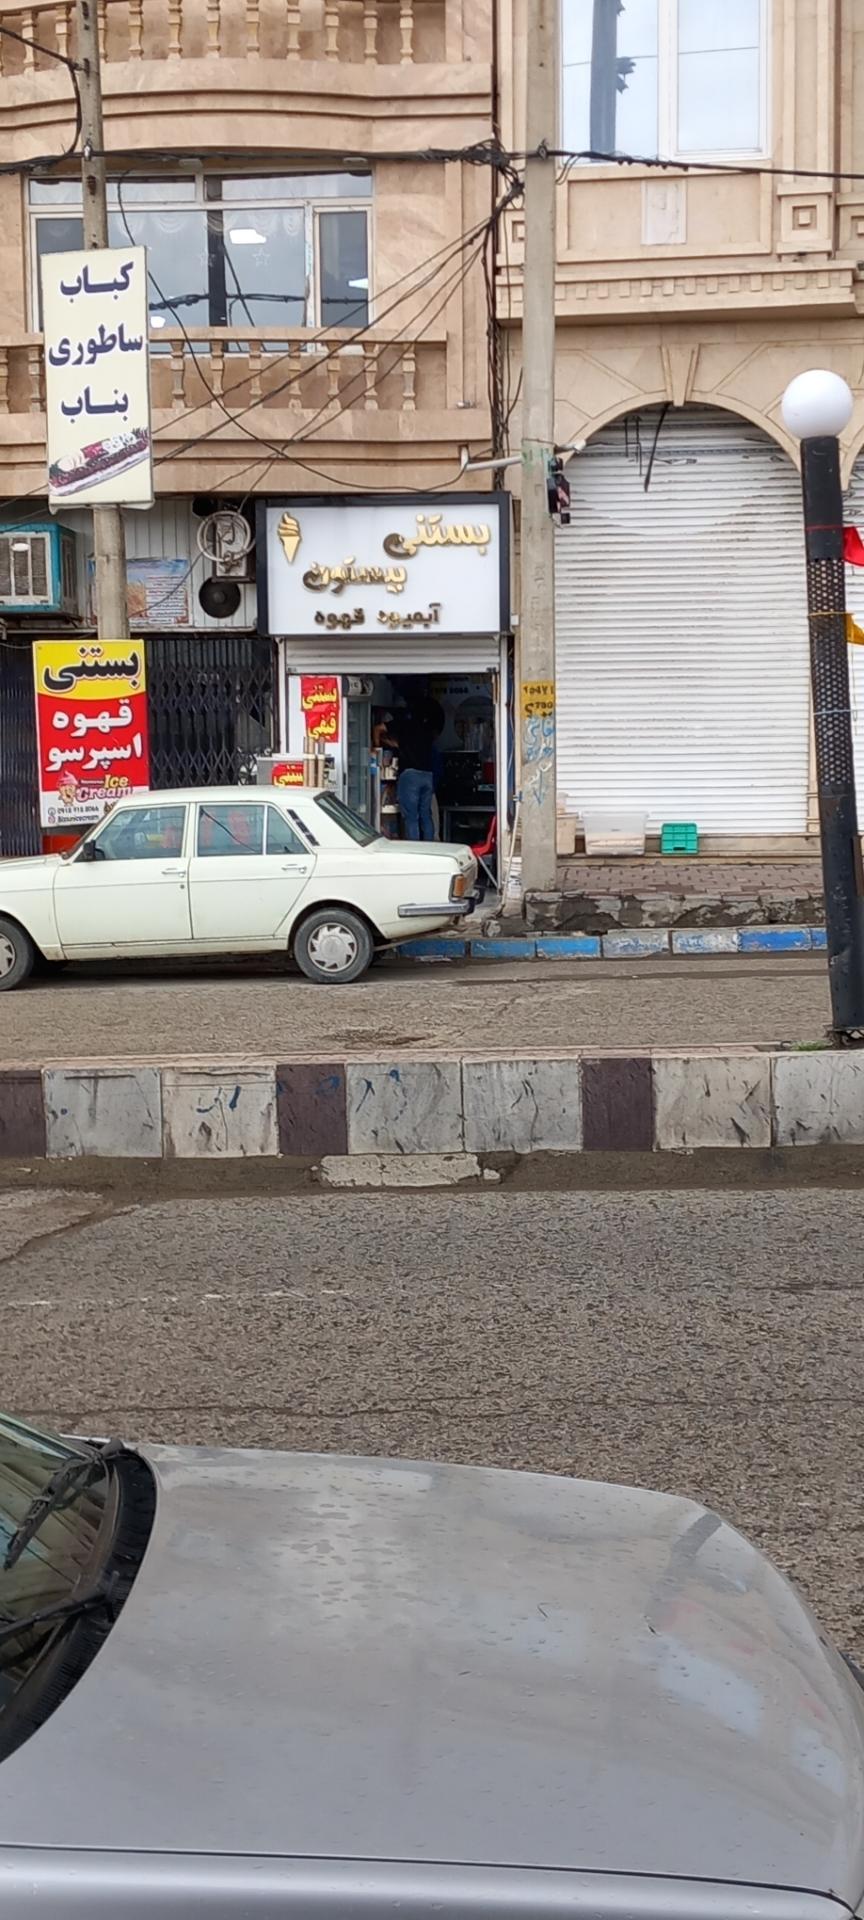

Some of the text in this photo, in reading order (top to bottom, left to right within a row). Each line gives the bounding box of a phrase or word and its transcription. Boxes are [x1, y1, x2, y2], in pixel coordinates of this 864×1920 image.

[60, 261, 134, 303] کباب
[48, 323, 143, 366] ساطوری
[60, 386, 130, 424] بناب
[382, 513, 491, 560] بستنی
[302, 557, 407, 594] بیستون
[314, 602, 441, 630] آبمیوه قهوه
[43, 645, 140, 692] بستنی
[302, 684, 337, 710] بستنی
[52, 698, 133, 737] قهوه
[45, 732, 143, 771] اسپرسو
[76, 786, 133, 802] Cream
[104, 773, 129, 788] Ice
